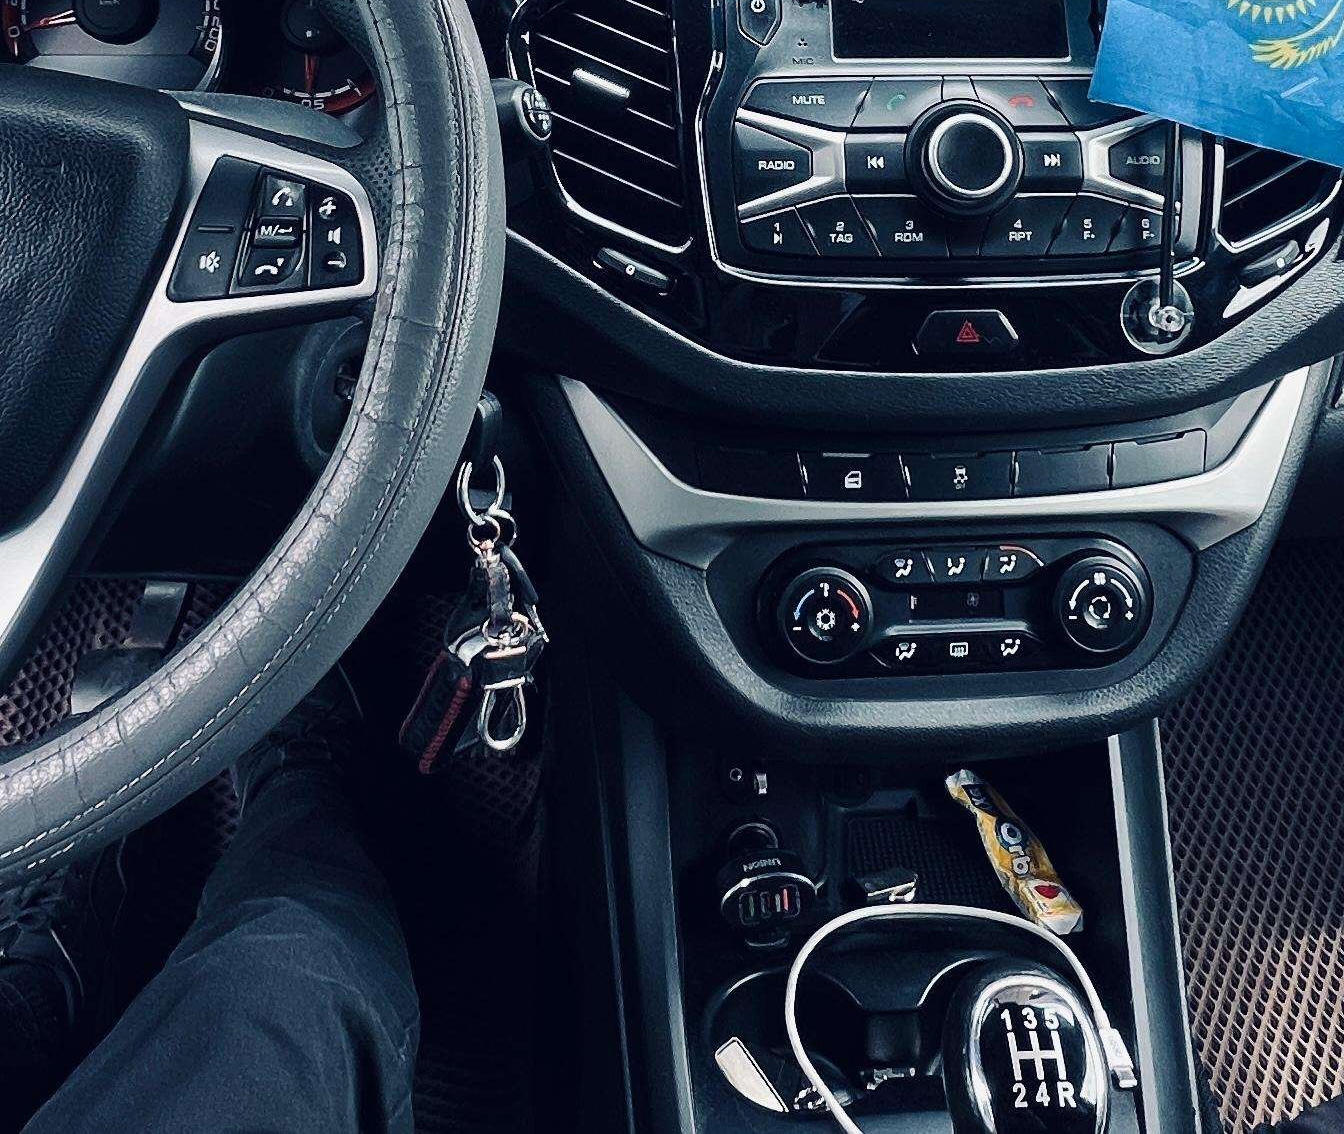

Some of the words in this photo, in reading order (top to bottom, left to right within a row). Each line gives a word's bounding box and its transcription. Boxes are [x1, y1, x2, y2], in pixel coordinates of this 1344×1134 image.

[8, 26, 20, 38] 0
[792, 57, 814, 65] MIC
[792, 95, 826, 105] MUTE
[758, 160, 795, 170] RADIO
[1126, 156, 1161, 165] AUDIO
[773, 222, 780, 231] 1
[836, 222, 845, 232] 2
[905, 220, 914, 230] 3
[1013, 219, 1022, 229] 4
[1083, 218, 1092, 229] 5
[829, 233, 854, 243] TAG
[894, 232, 924, 242] RDM
[1008, 231, 1033, 242] RPT
